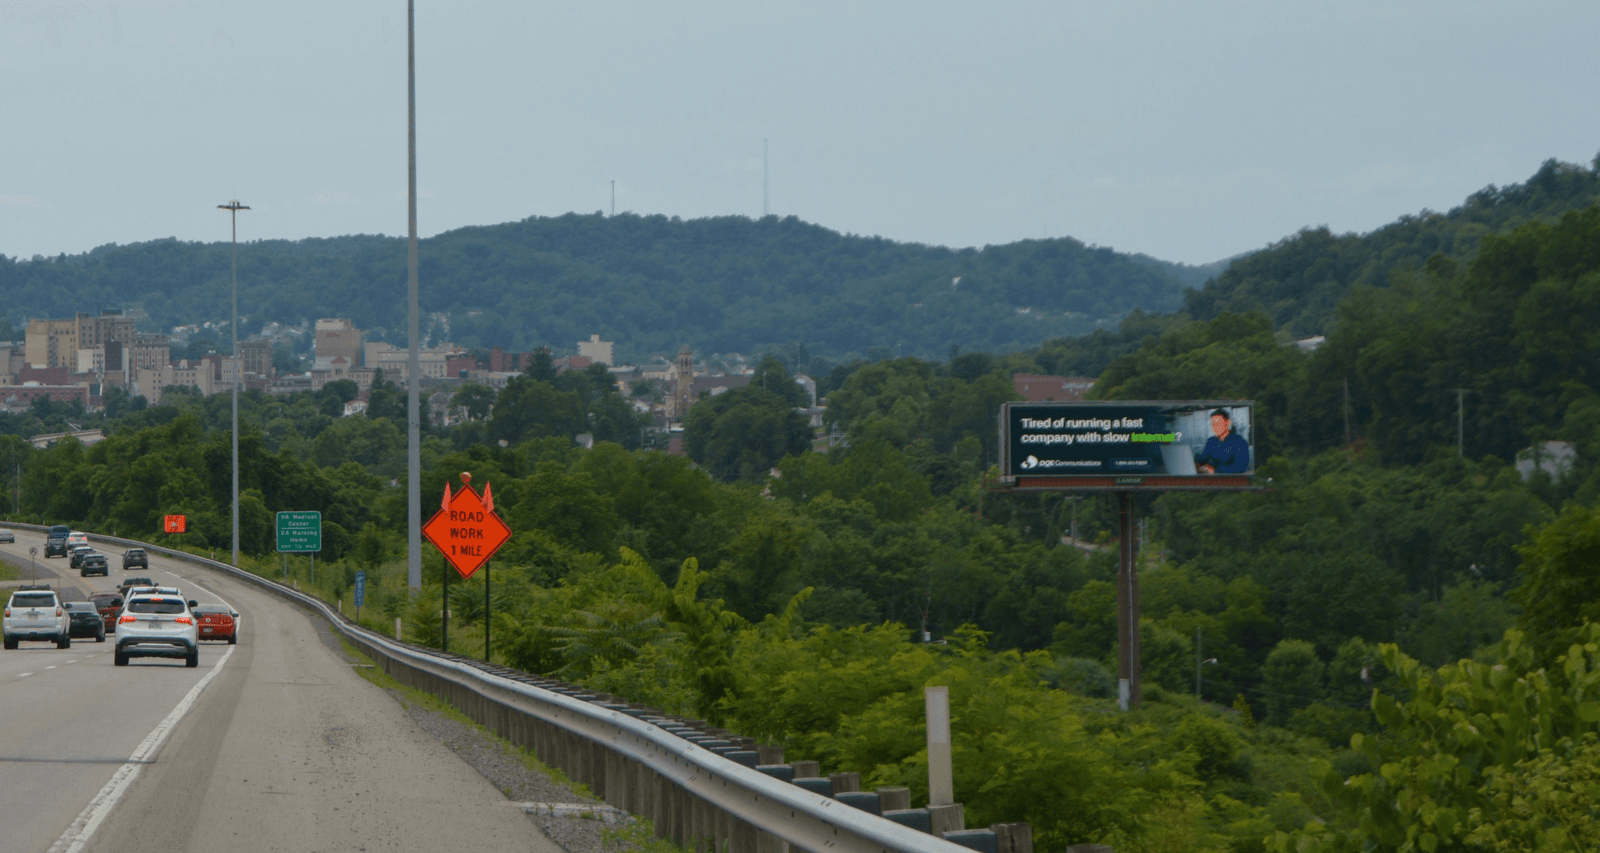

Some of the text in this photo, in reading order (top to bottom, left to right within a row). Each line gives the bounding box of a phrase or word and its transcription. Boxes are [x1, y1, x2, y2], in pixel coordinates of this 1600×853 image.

[1020, 417, 1143, 430] Tired of running a fast
[1020, 433, 1074, 444] company
[1076, 431, 1101, 442] with
[1103, 431, 1130, 442] slow
[1039, 459, 1102, 467] DQE Communications
[450, 510, 484, 523] ROAD
[450, 527, 484, 540] WORK
[451, 544, 484, 557] 1 MILE
